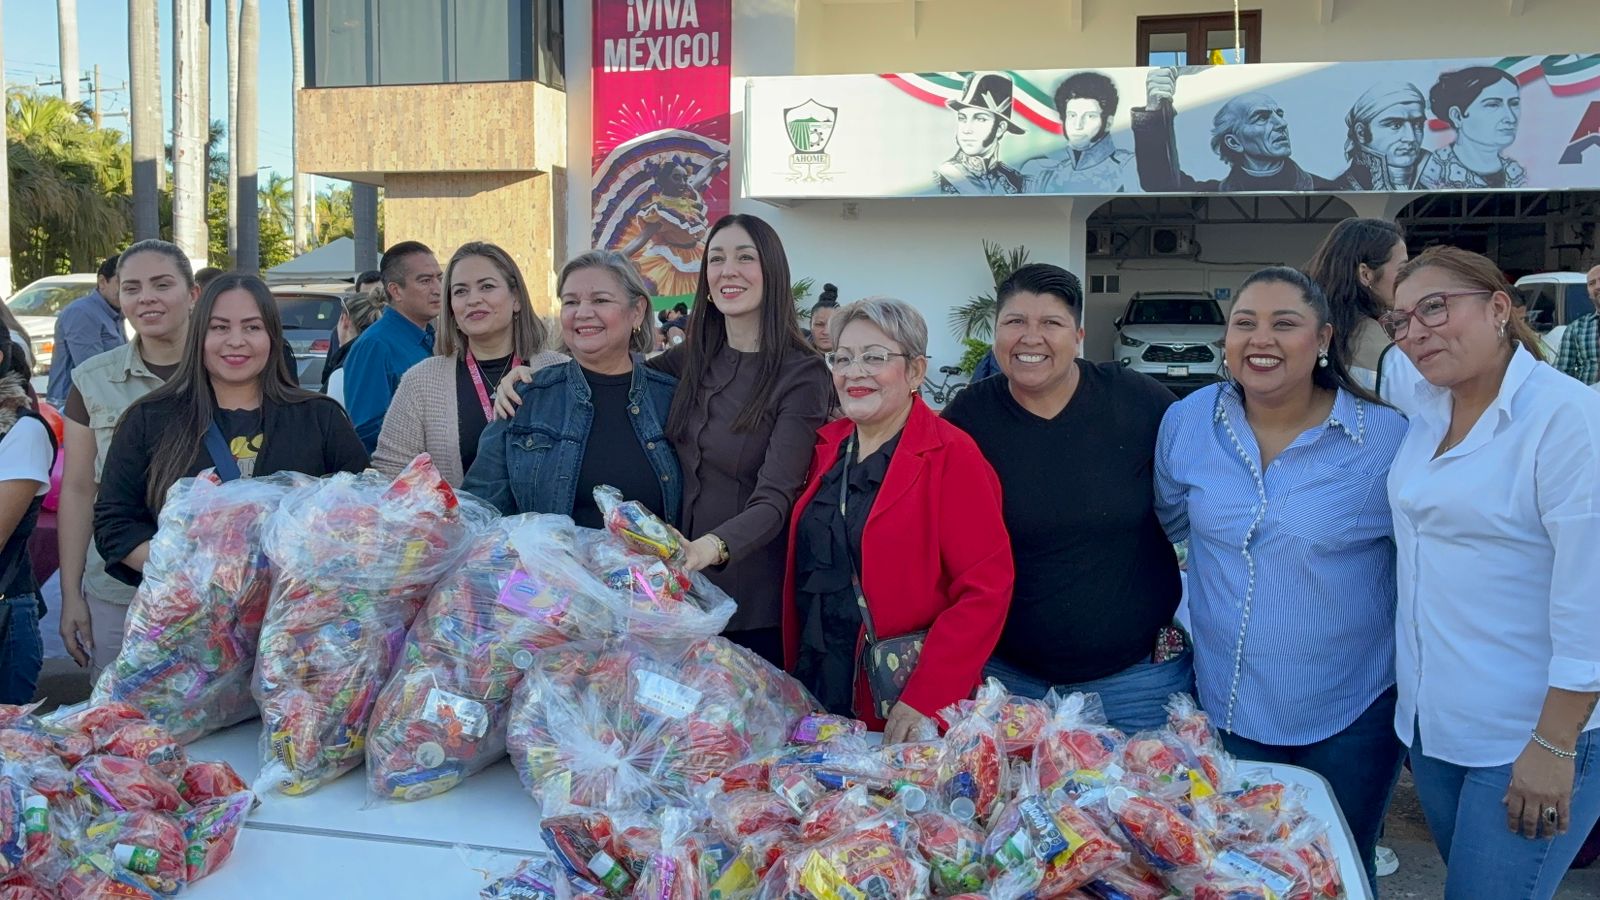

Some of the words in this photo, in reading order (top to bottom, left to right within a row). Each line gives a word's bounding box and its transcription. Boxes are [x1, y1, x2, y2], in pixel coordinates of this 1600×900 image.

[626, 0, 700, 32] ¡VIVA
[603, 31, 719, 73] MÉXICO!
[795, 154, 825, 163] AHOME
